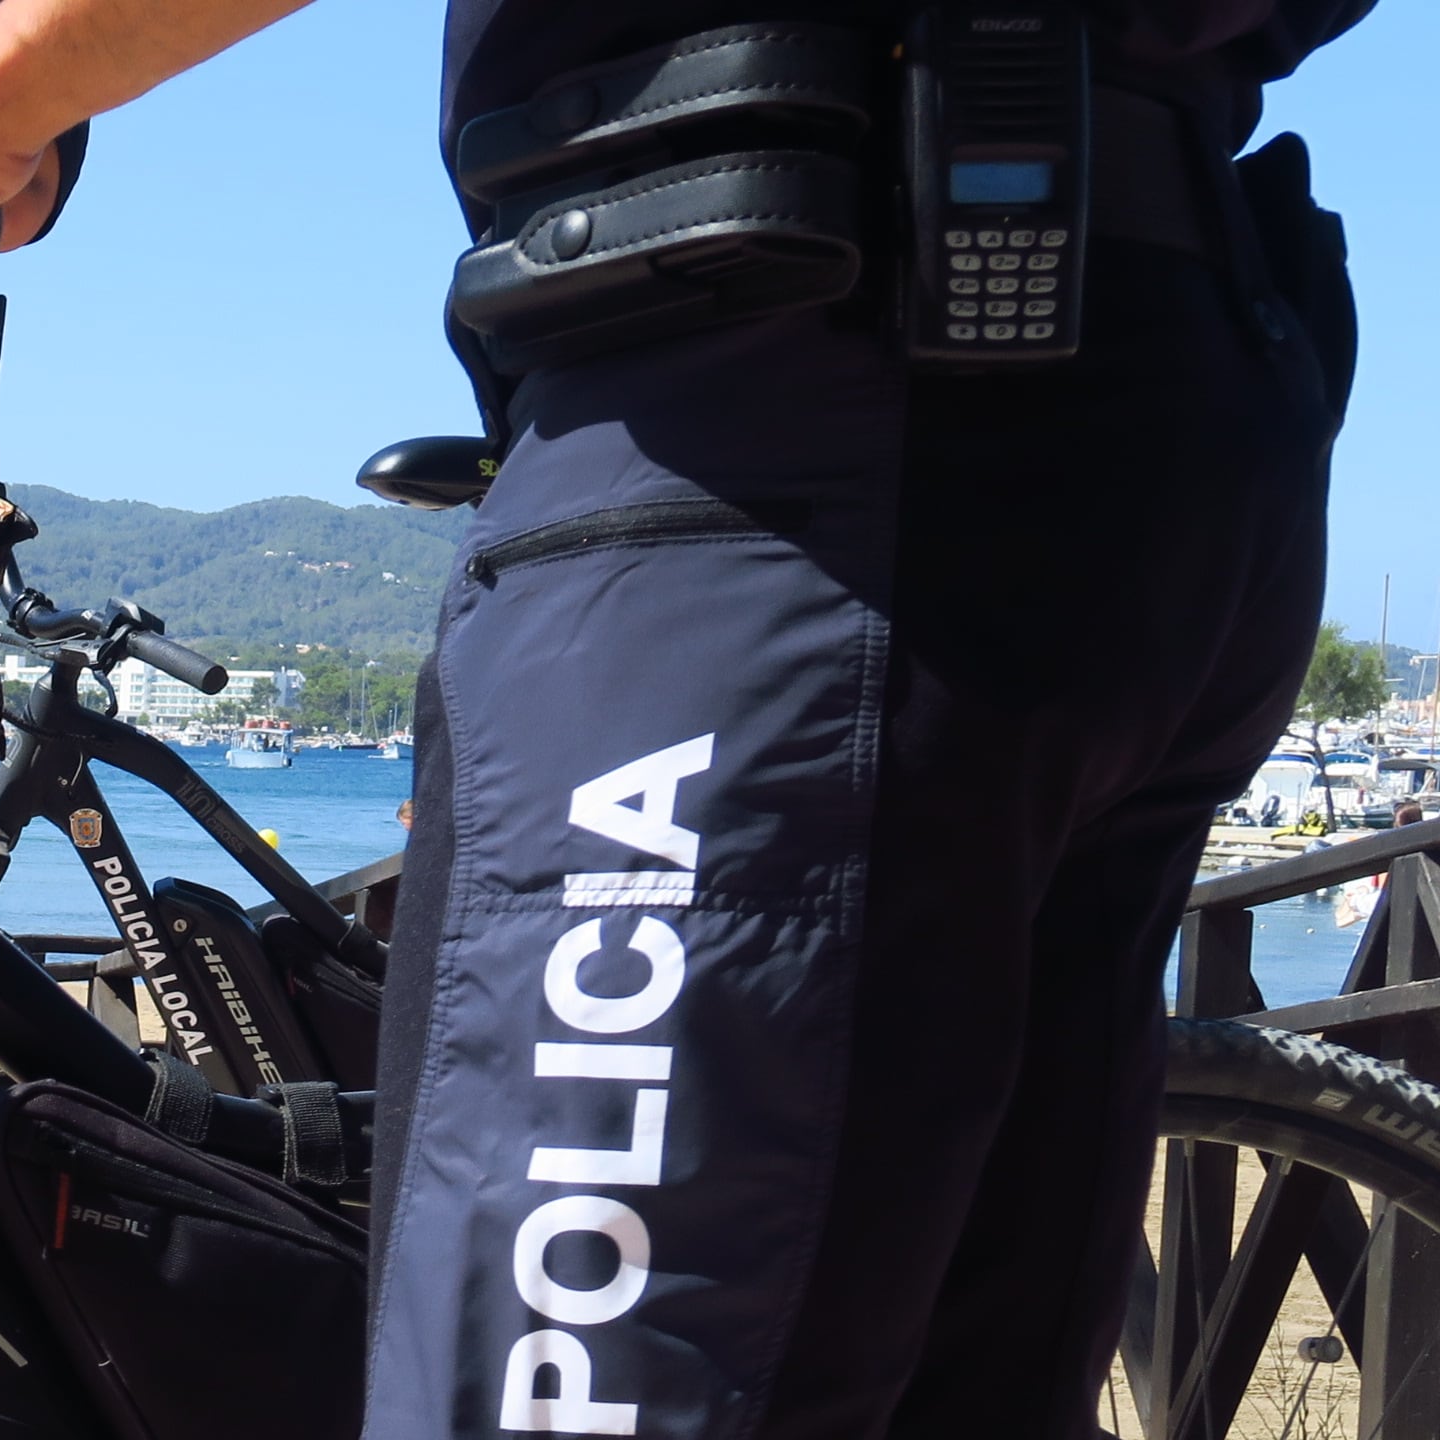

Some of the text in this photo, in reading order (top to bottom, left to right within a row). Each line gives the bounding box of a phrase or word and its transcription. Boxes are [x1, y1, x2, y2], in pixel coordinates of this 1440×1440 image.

[93, 855, 214, 1067] POLICIA LOCAL
[498, 731, 716, 1436] POLICIA
